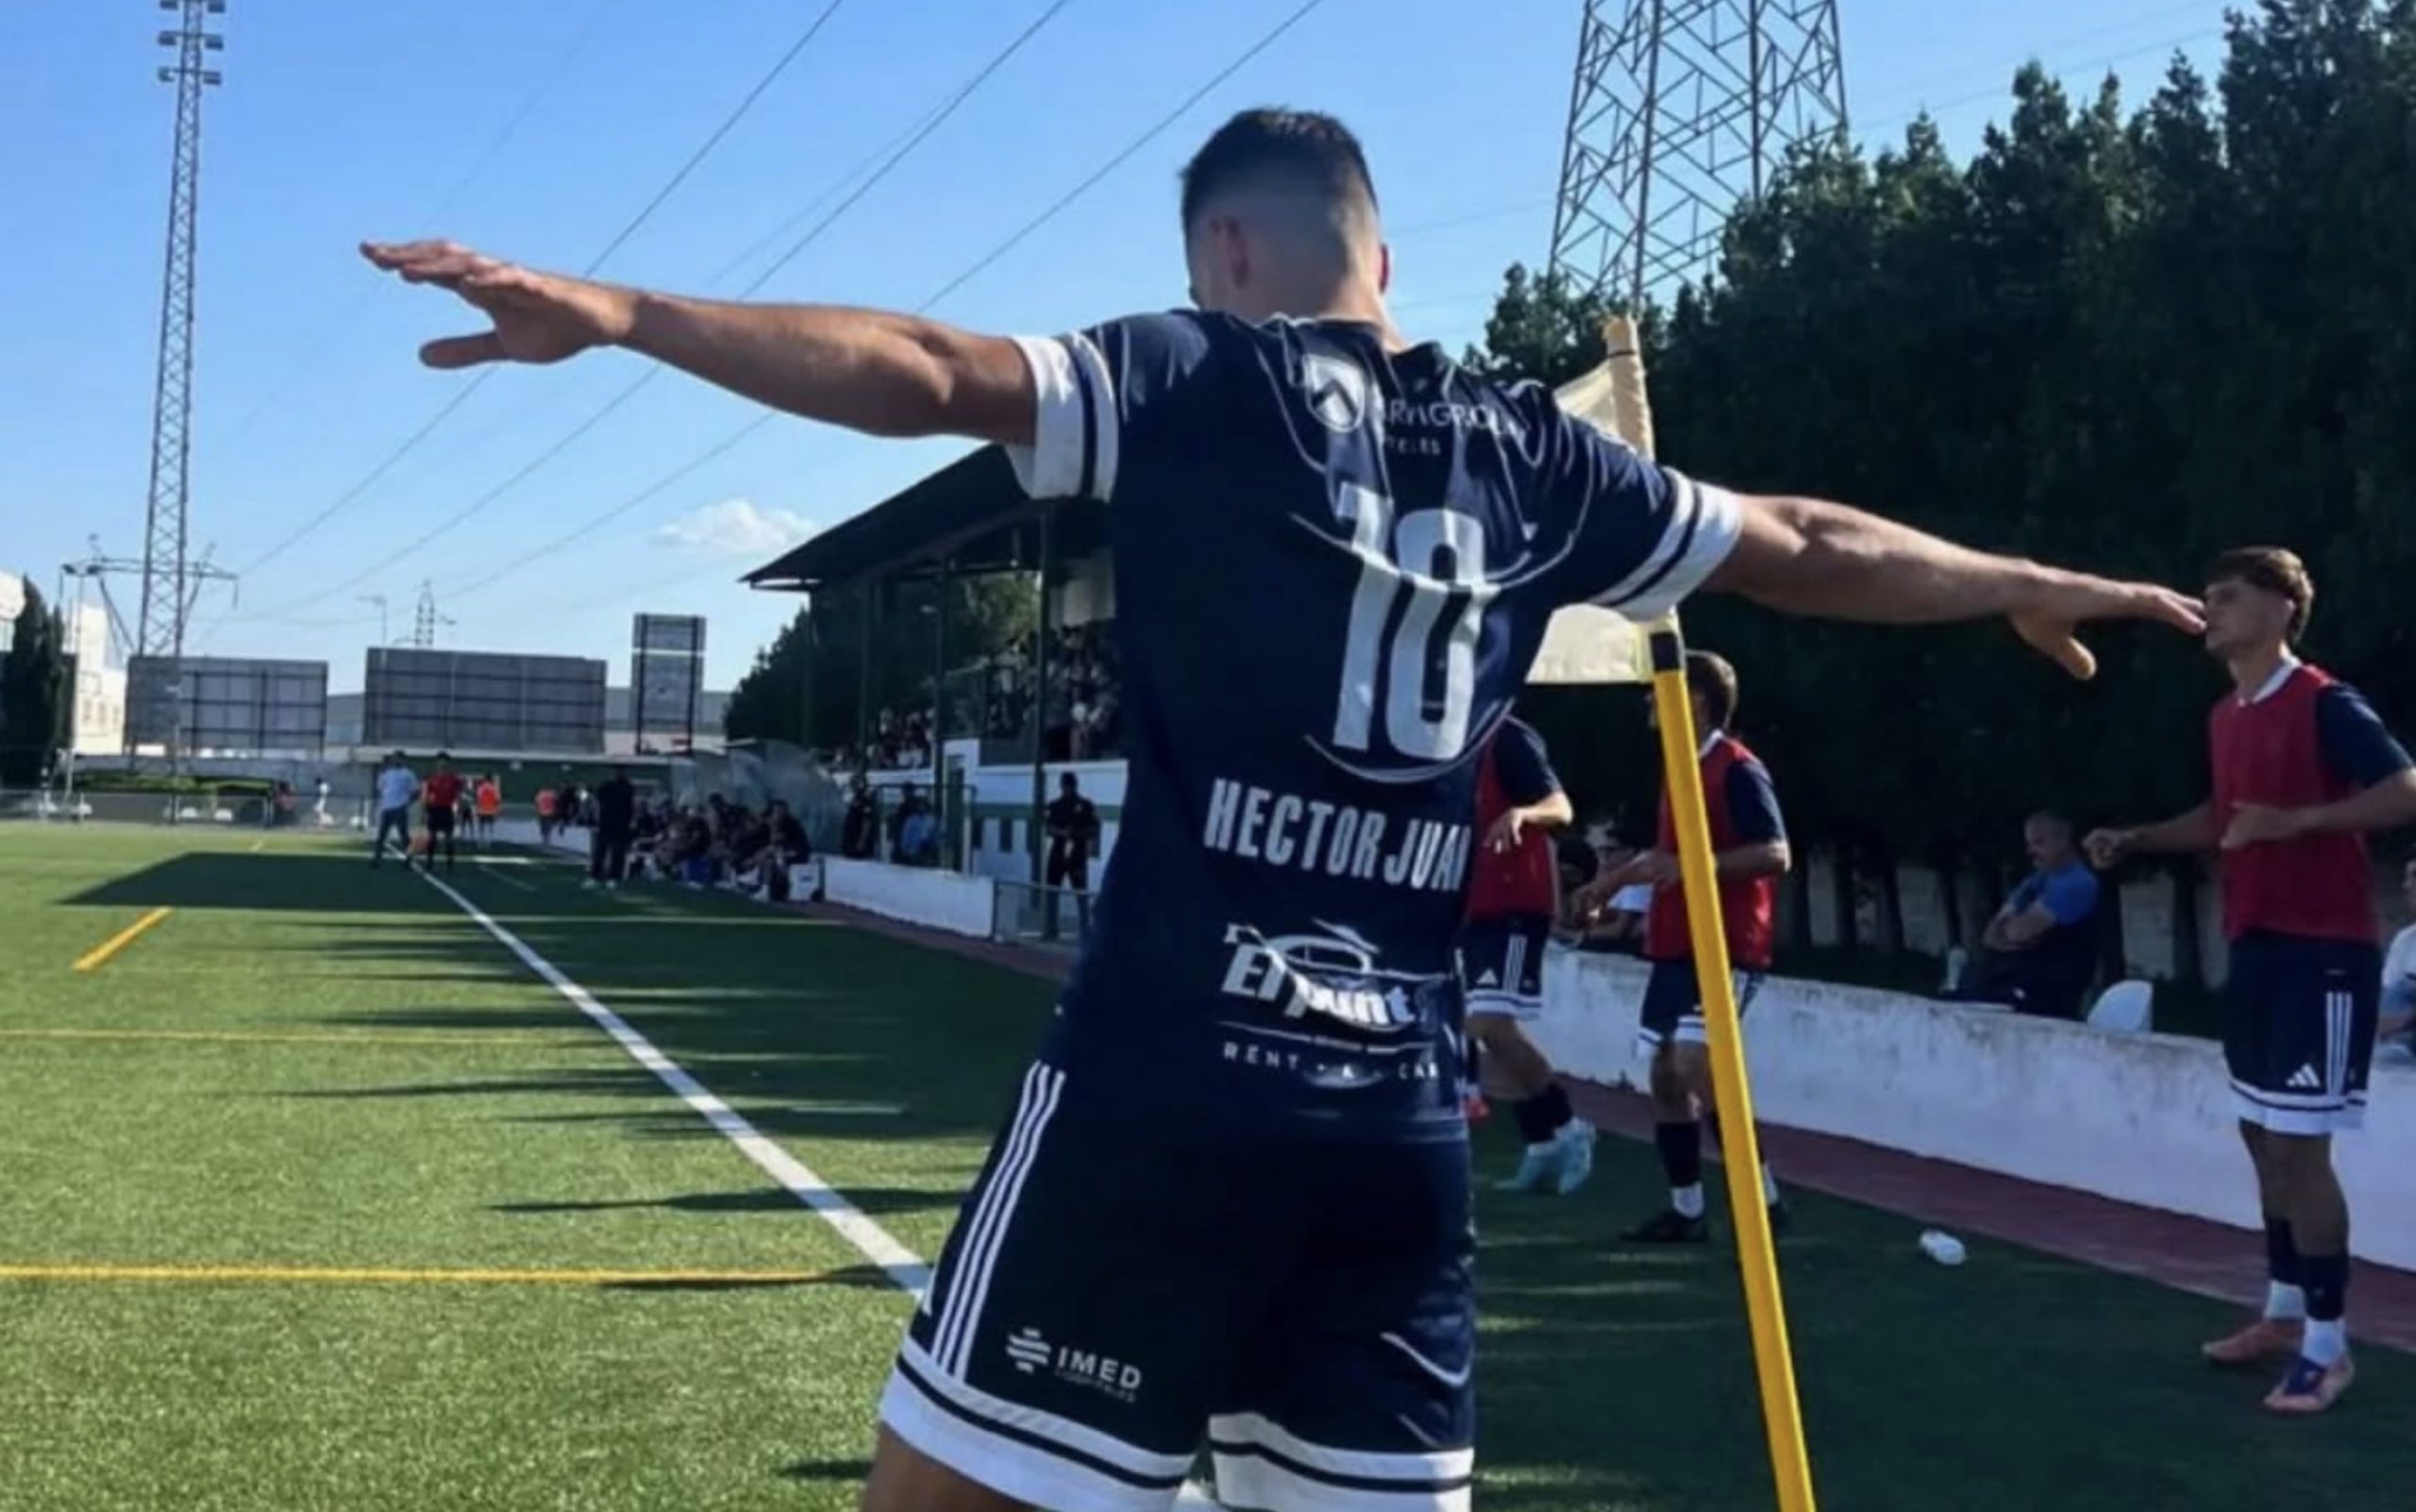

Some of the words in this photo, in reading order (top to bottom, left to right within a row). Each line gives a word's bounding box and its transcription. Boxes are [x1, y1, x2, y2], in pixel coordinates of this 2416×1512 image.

[1332, 480, 1488, 761] 10
[1202, 777, 1387, 879] HECTOR
[1222, 1041, 1300, 1070] RENT
[1057, 1346, 1142, 1390] IMED
